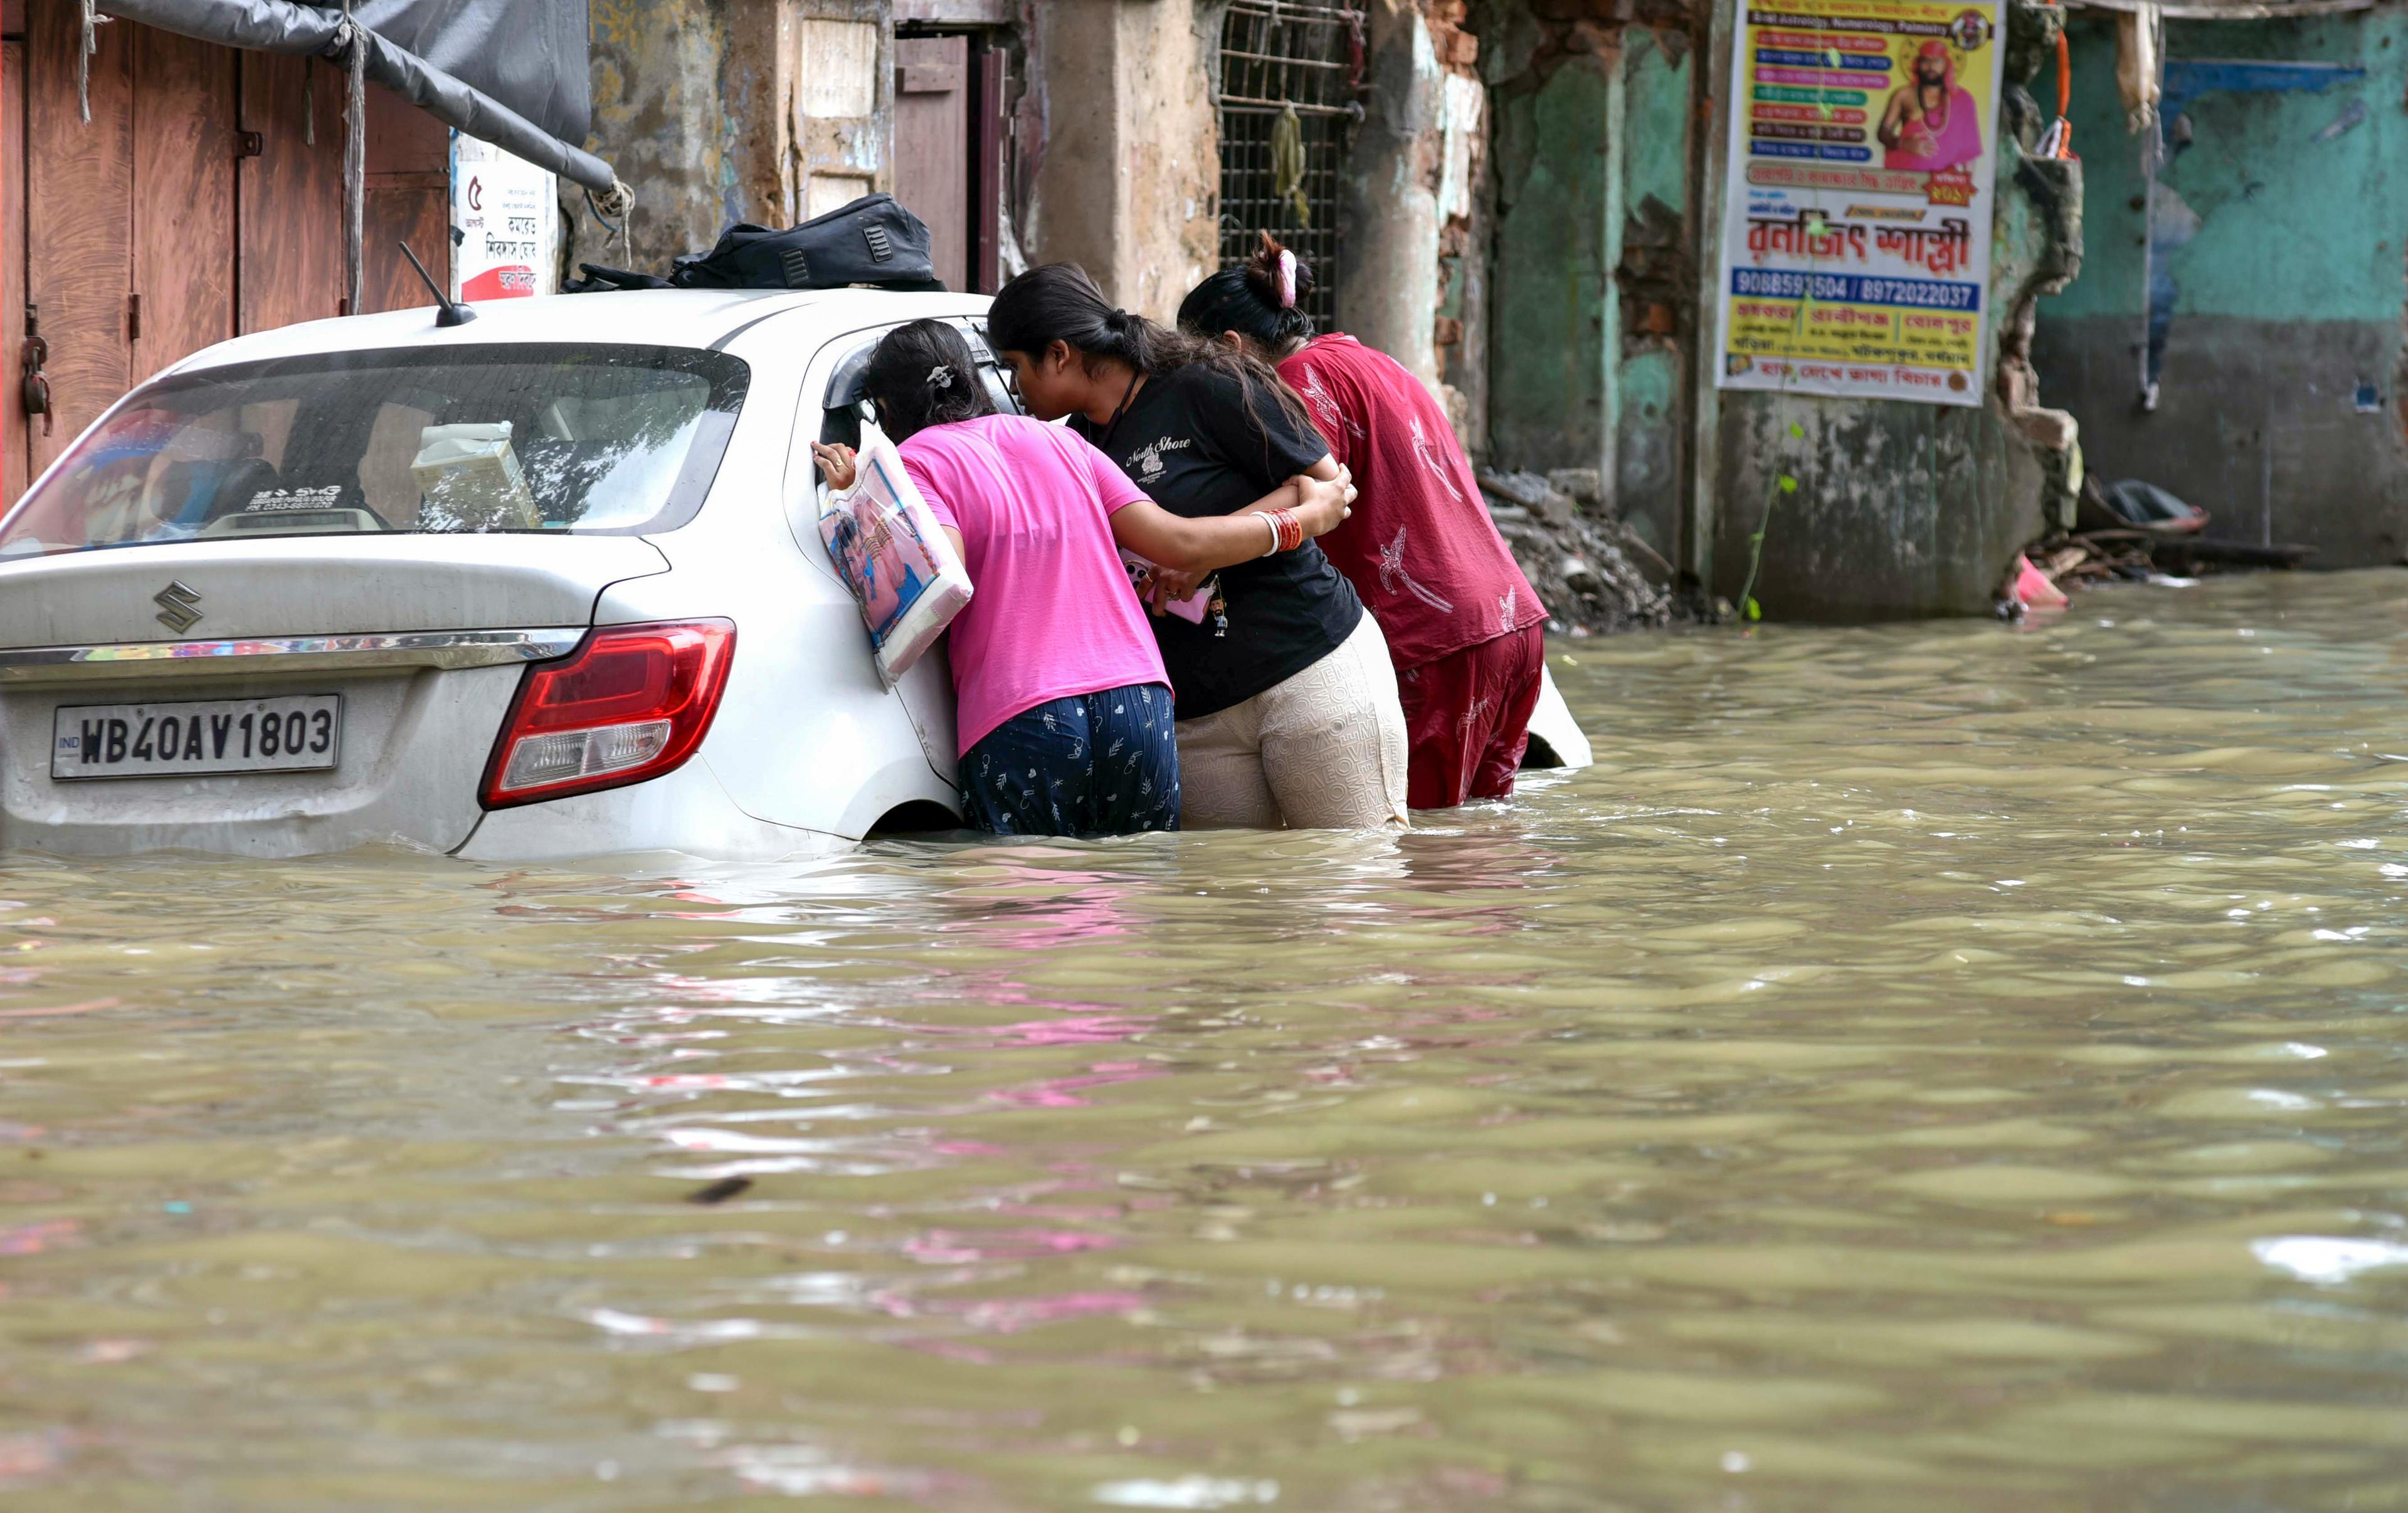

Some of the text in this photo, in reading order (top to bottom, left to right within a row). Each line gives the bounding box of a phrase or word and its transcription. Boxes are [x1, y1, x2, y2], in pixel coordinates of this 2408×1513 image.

[468, 176, 482, 211] ৫
[509, 217, 536, 235] কমরেড
[485, 231, 536, 260] শিবদাস ঘোষ
[1874, 217, 1972, 276] শাস্ত্রী
[1860, 280, 1972, 307] 8972022037
[1894, 365, 1941, 387] বিচার
[1126, 436, 1191, 467] North Shore
[59, 737, 80, 749] IND
[82, 709, 331, 764] WB40AV1803
